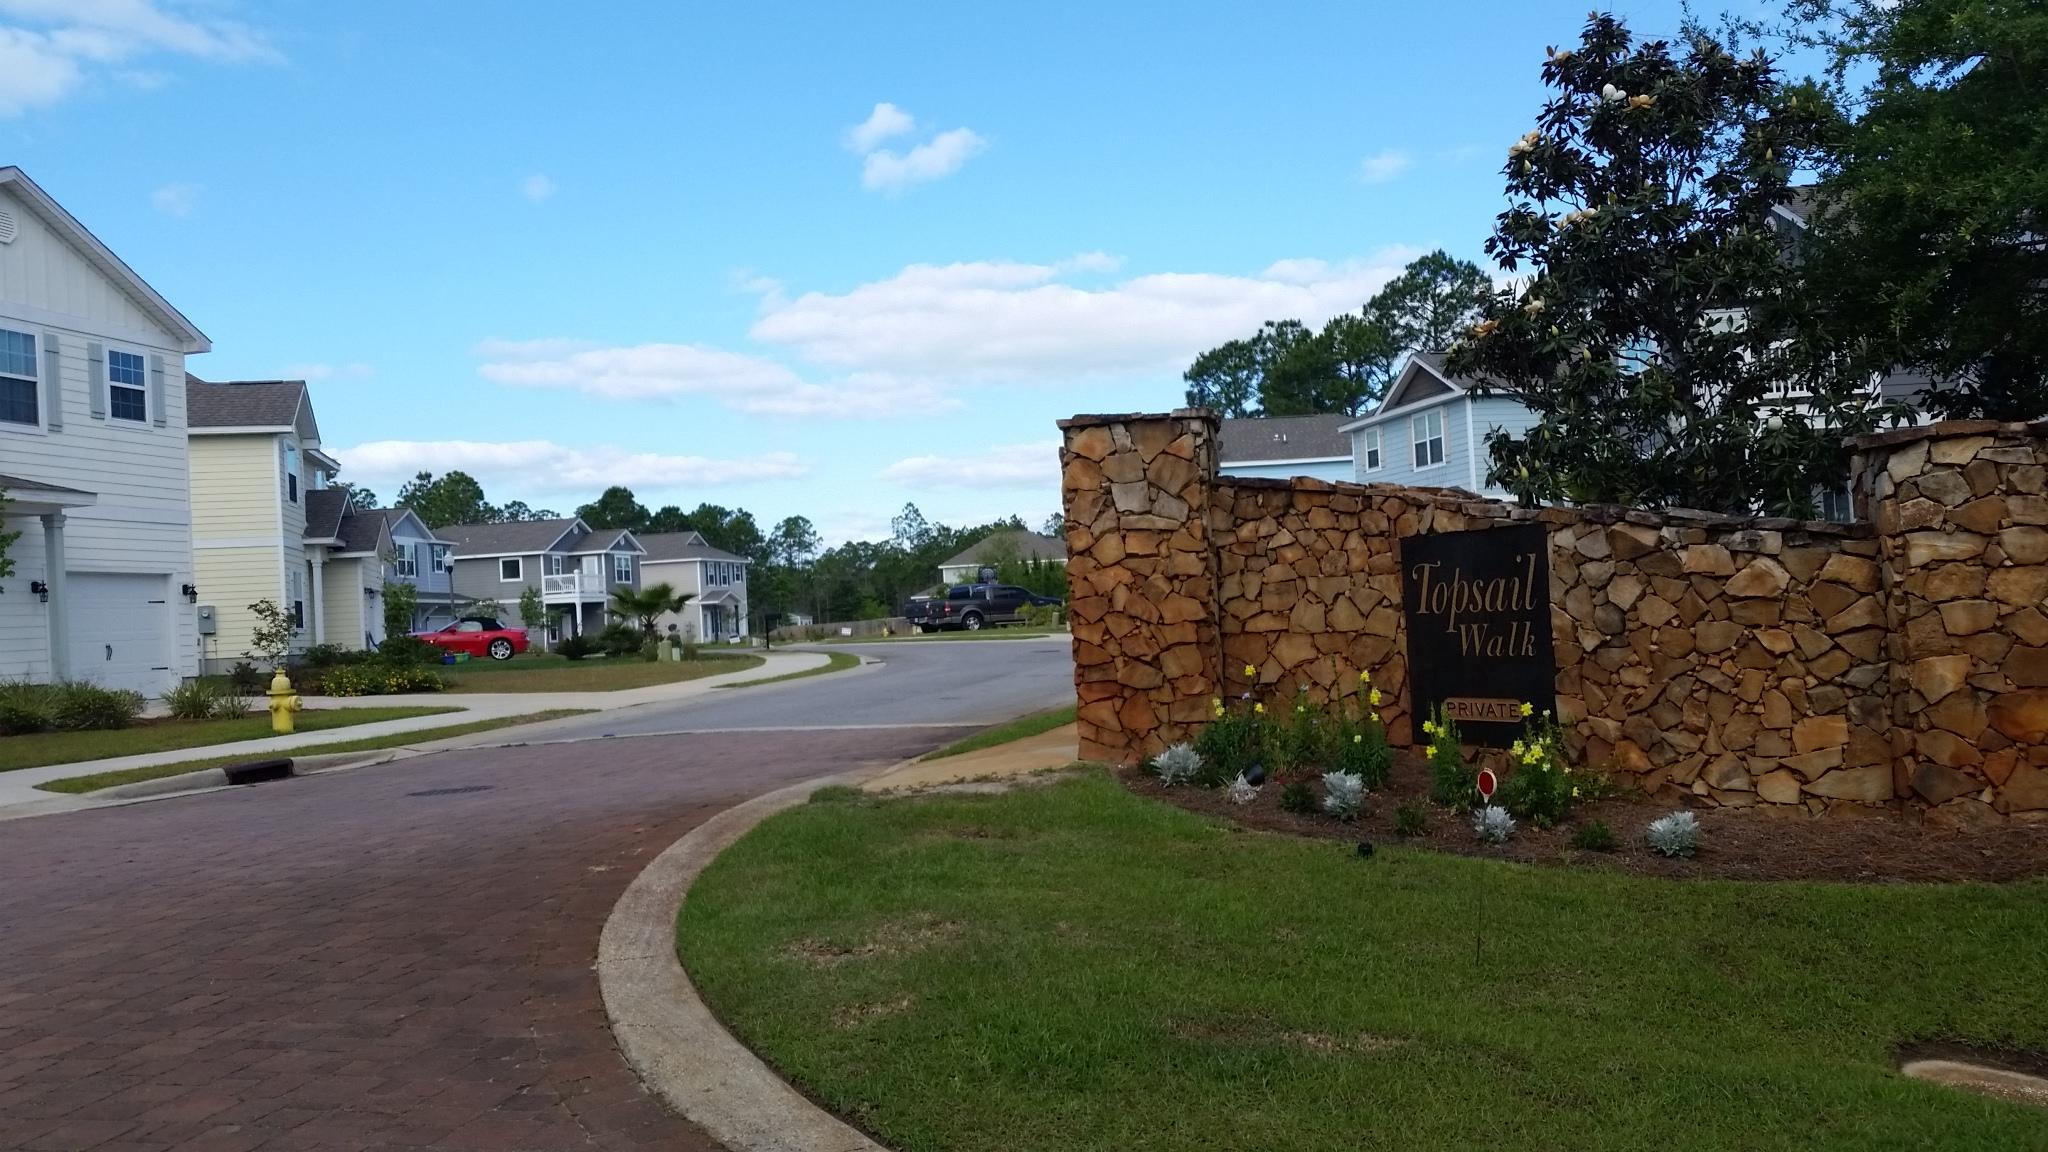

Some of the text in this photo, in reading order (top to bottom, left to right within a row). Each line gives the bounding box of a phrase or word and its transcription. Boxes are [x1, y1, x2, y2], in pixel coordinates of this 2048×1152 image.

[1412, 553, 1537, 633] Topsail
[1459, 621, 1536, 657] Walk
[1446, 701, 1520, 718] PRIVATE
